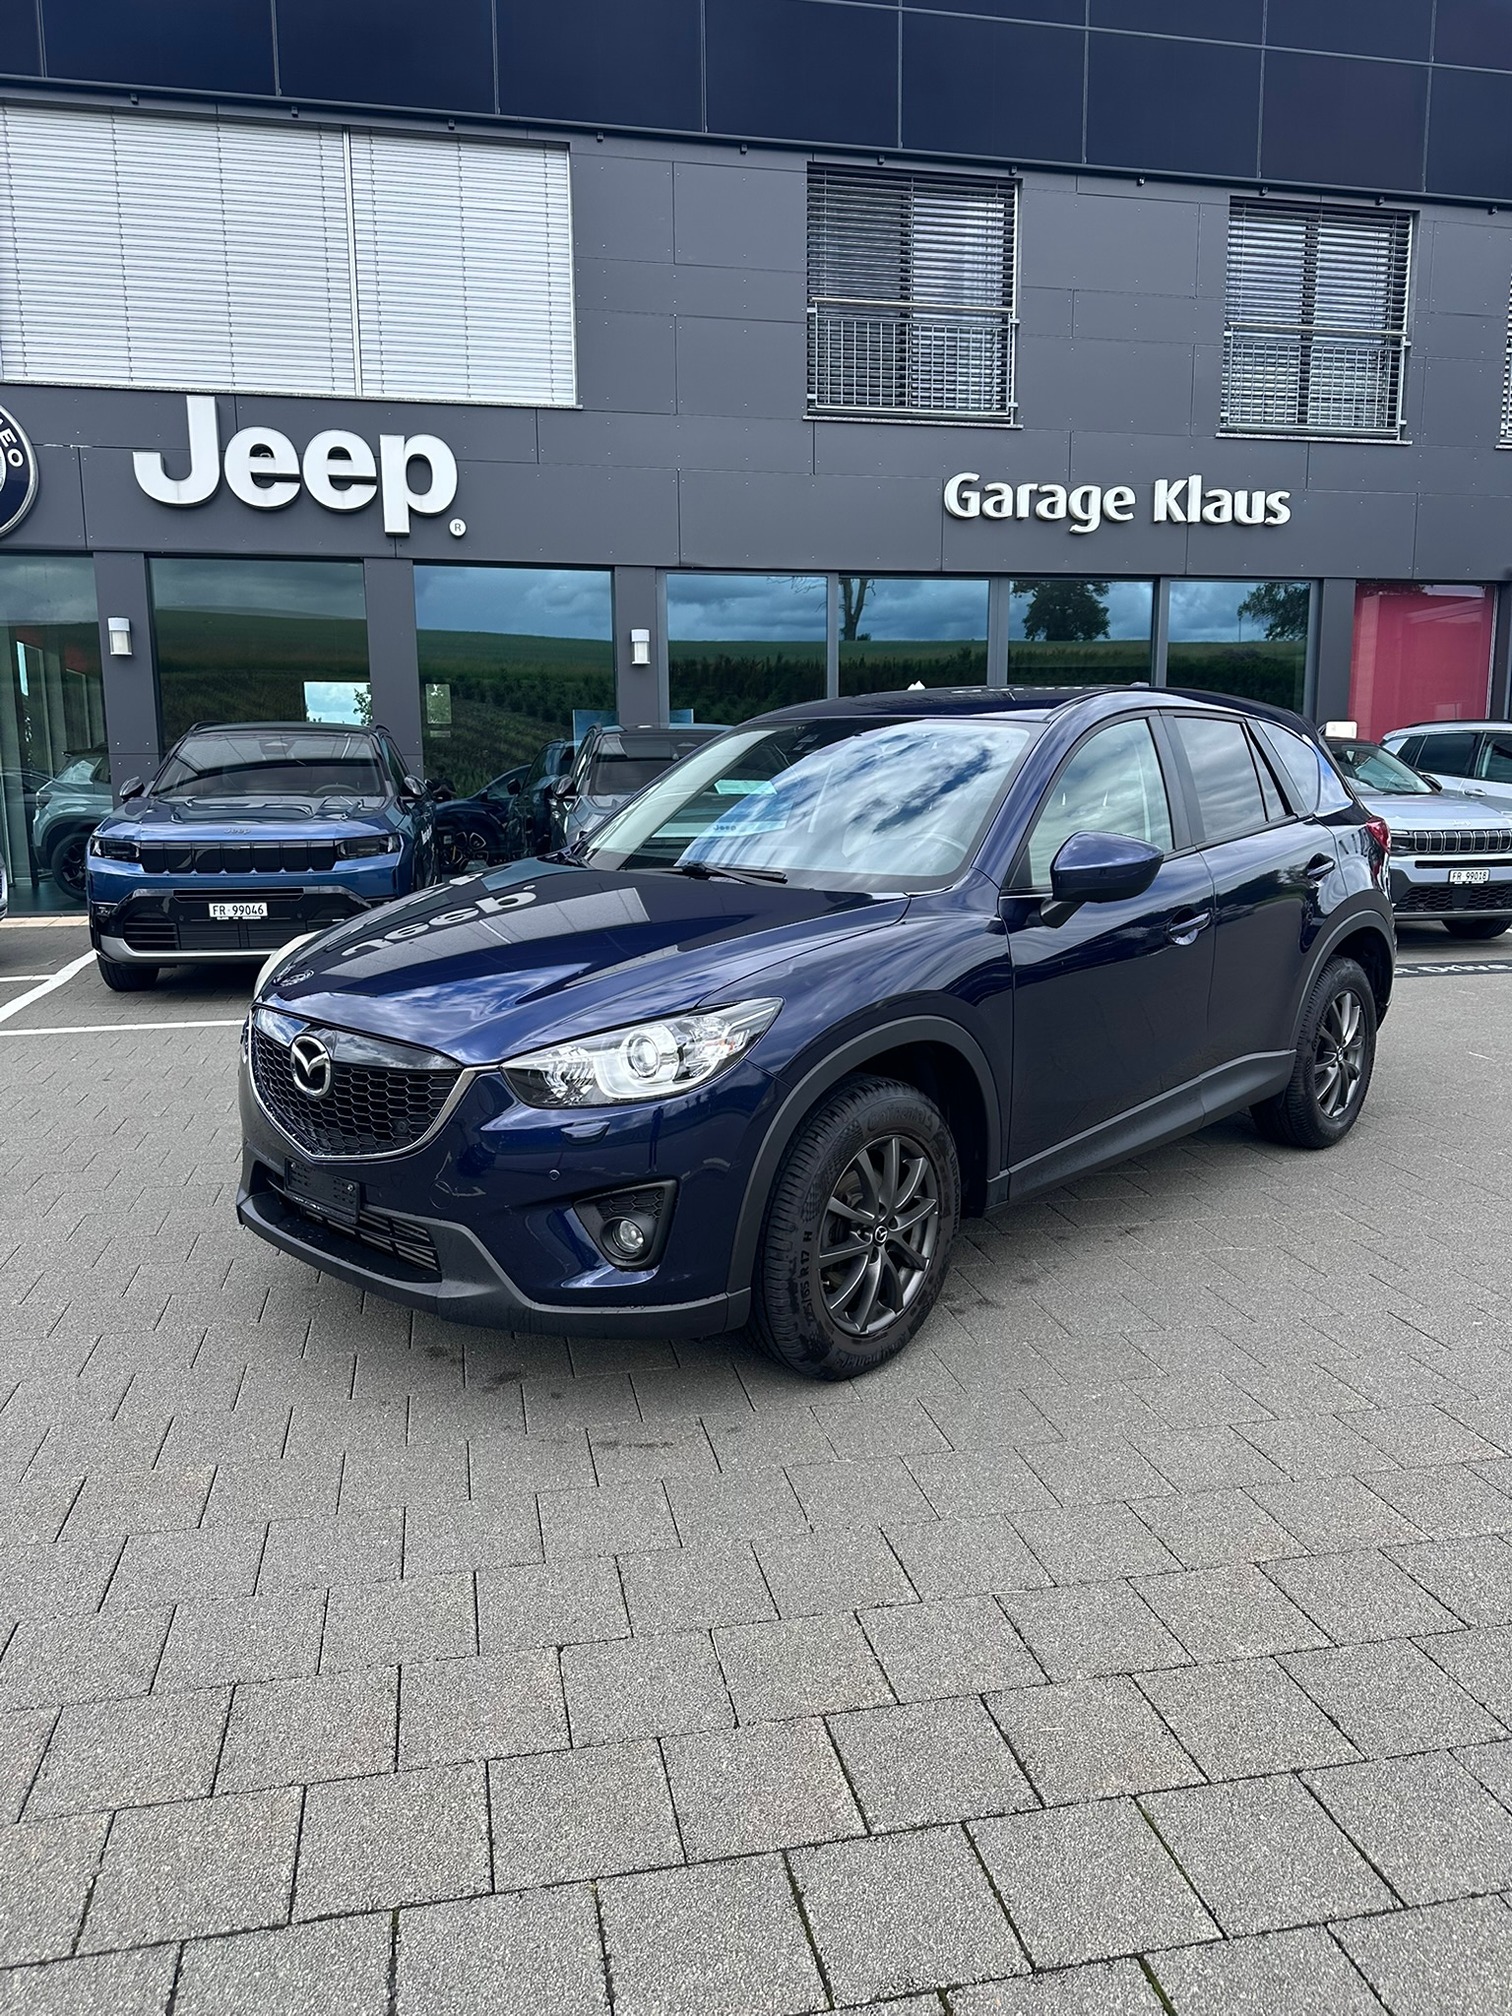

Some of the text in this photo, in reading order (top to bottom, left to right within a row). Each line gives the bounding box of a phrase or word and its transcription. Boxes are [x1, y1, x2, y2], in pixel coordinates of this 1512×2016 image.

[133, 394, 459, 536] Jeep
[944, 472, 1291, 534] Garage Klaus
[223, 826, 252, 836] Jeep
[1452, 871, 1462, 880] FR
[212, 904, 264, 916] FR 99046
[802, 1231, 813, 1242] H
